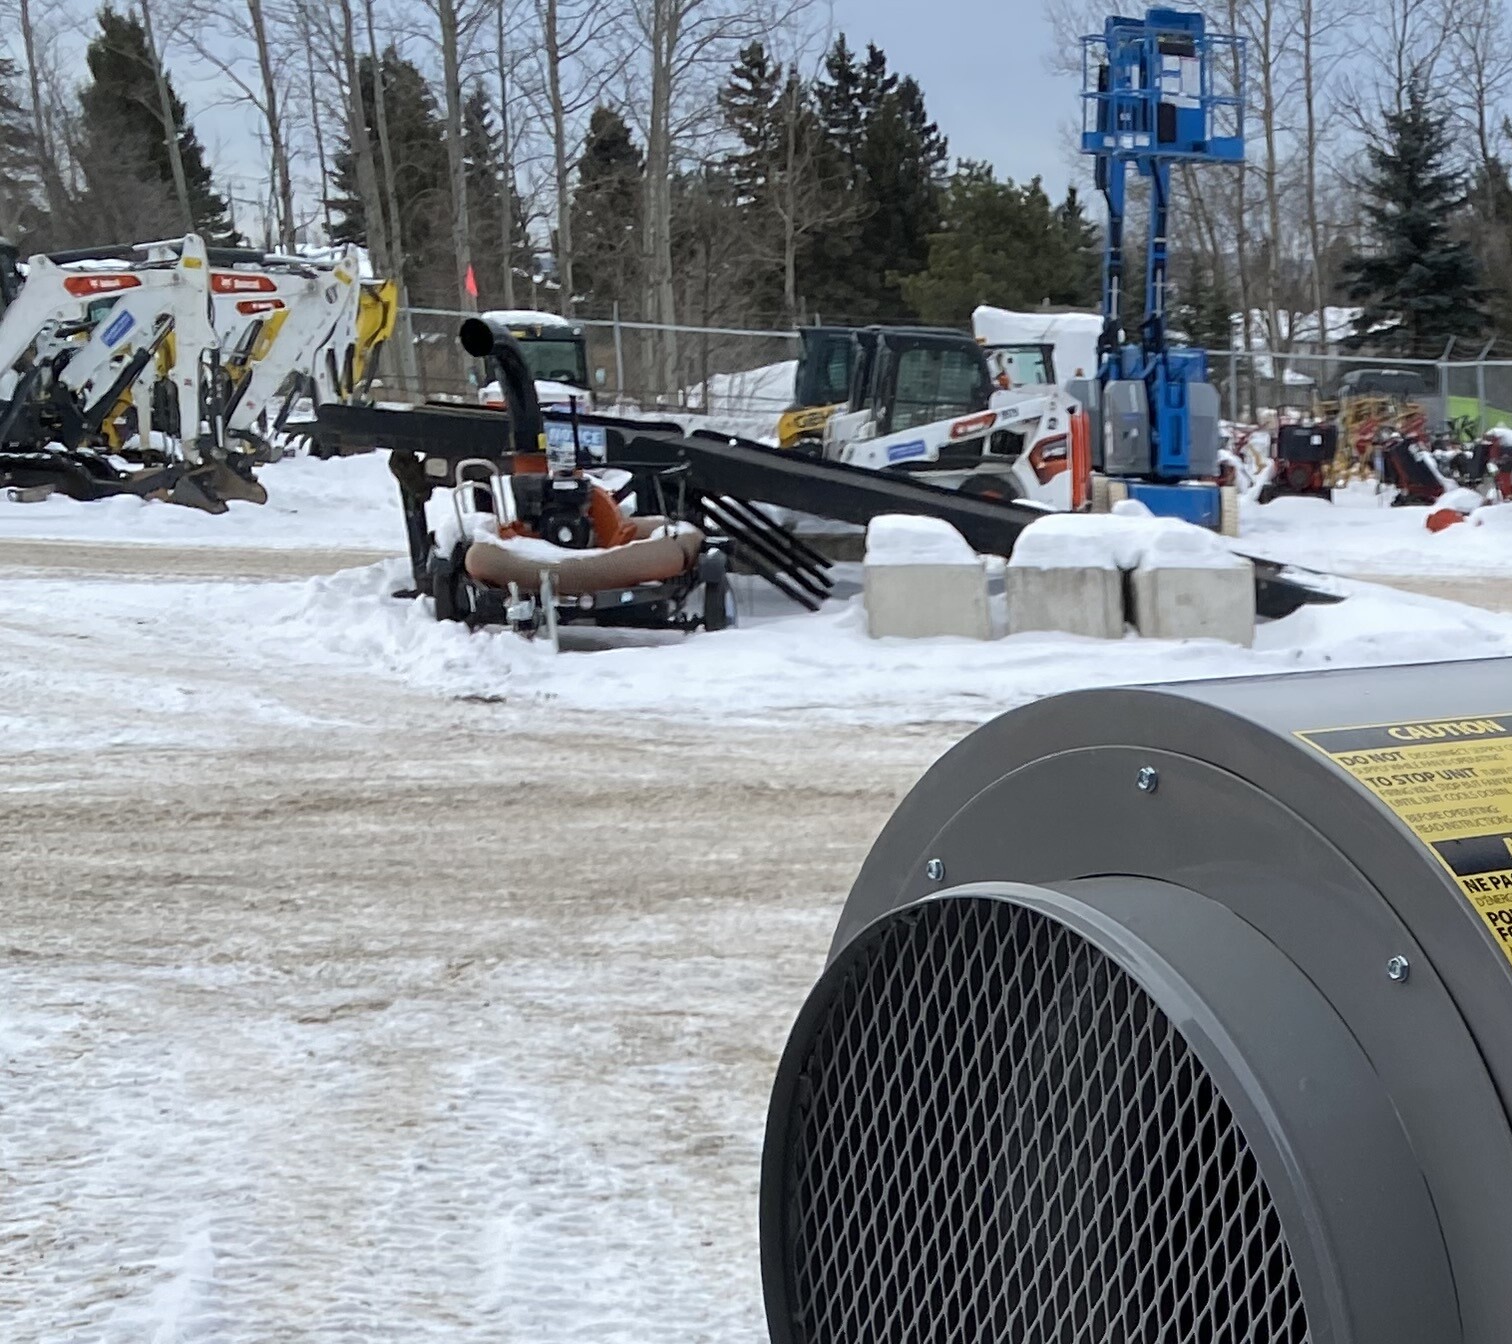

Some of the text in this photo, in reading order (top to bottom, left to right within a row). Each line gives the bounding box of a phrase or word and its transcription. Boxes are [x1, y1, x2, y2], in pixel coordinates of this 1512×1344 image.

[1388, 719, 1507, 740] CAUTION
[1338, 751, 1408, 765] DO NOT
[1362, 767, 1482, 787] TO STOP UNIT
[1463, 877, 1491, 893] NE
